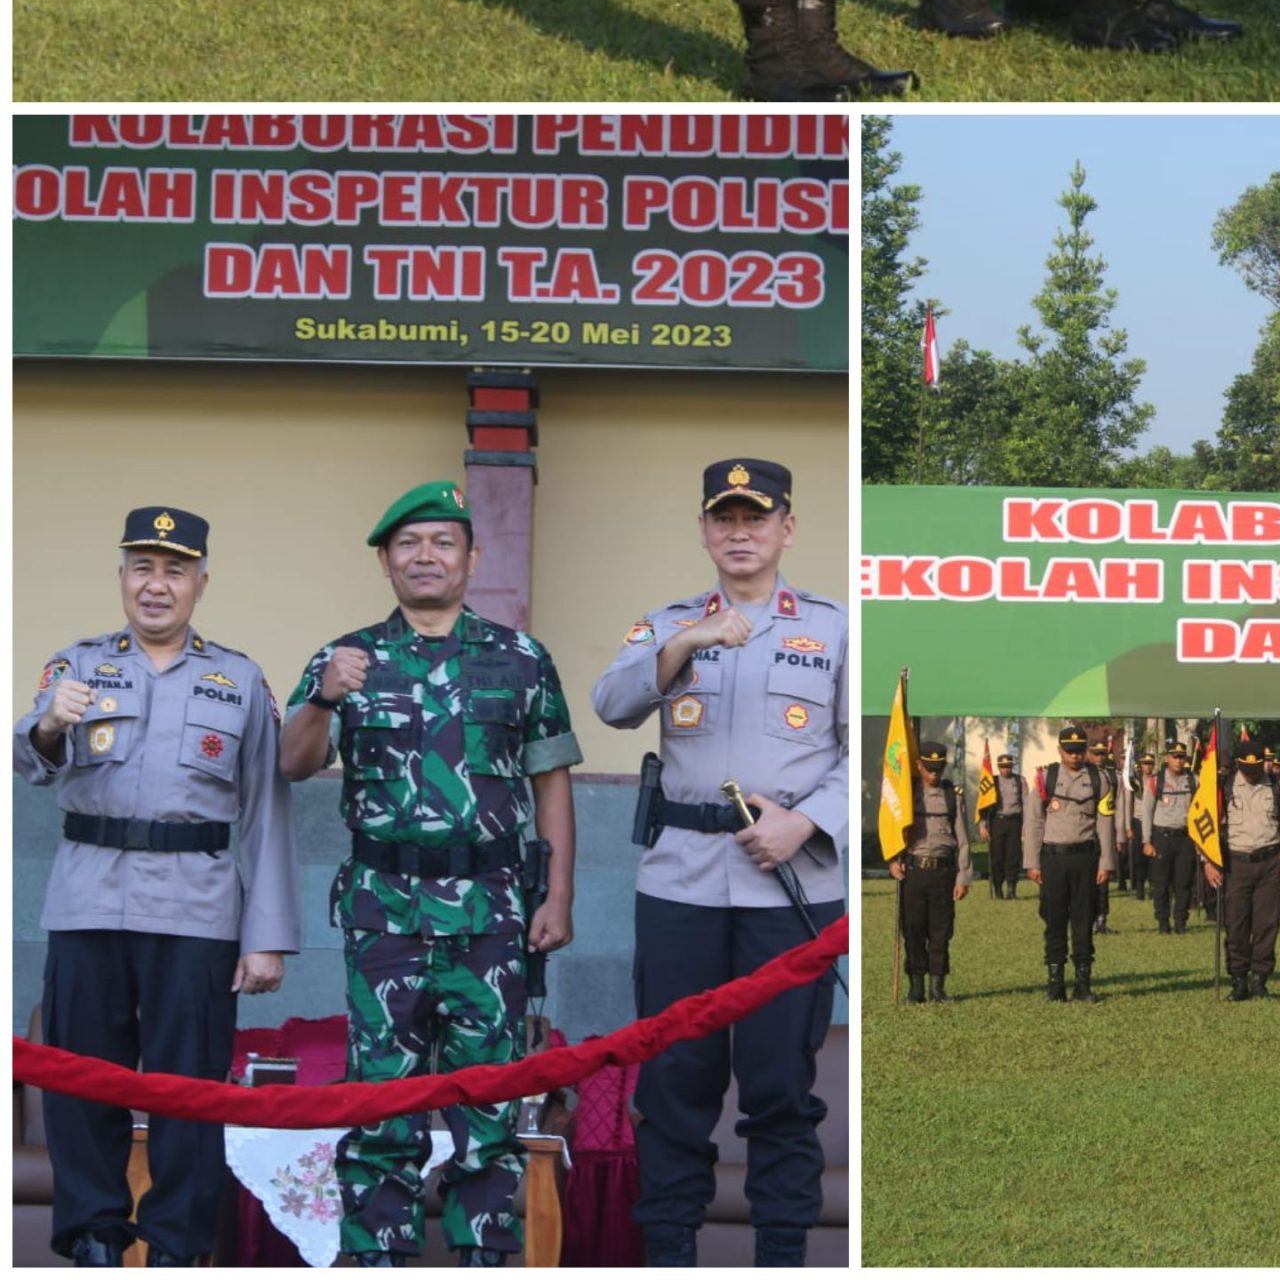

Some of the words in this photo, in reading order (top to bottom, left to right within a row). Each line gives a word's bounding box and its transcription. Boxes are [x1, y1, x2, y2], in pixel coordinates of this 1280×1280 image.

[70, 115, 516, 151] KOLABORASI
[212, 172, 606, 228] INSPEKTUR
[206, 245, 350, 297] DAN
[366, 248, 484, 300] TNI
[501, 250, 619, 302] T.A.
[634, 252, 824, 306] 2023
[295, 317, 470, 346] Sukabumi,
[481, 320, 570, 345] 15-20
[581, 323, 638, 346] Mei
[653, 325, 733, 348] 2023
[861, 556, 1162, 602] KOLAH
[774, 652, 831, 671] POLRI
[193, 685, 243, 706] POLRI
